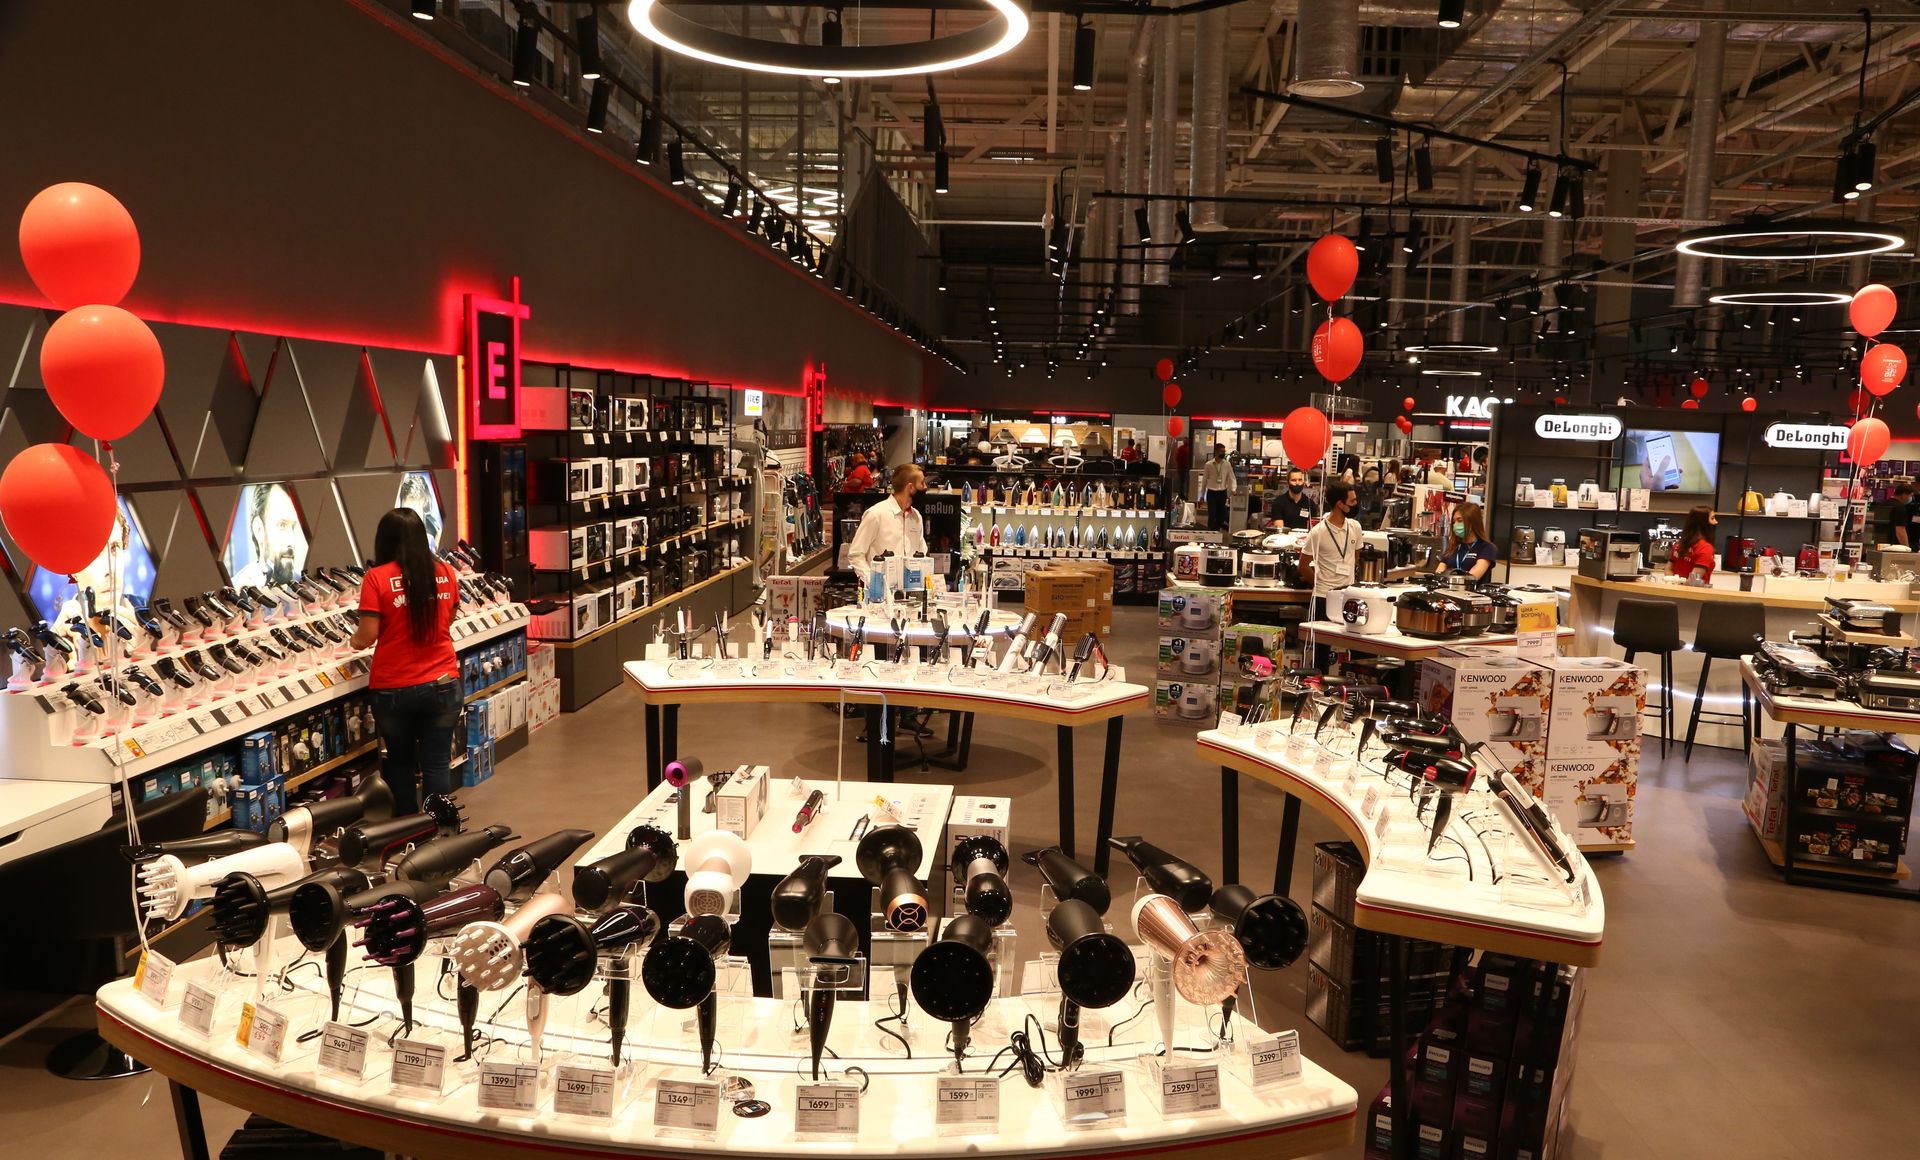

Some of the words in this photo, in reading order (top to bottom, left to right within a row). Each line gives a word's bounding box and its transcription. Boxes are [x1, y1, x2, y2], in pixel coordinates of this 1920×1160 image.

[488, 342, 506, 399] E
[1543, 420, 1613, 437] DeLonghi
[1776, 429, 1845, 446] DeLonghi
[925, 502, 954, 515] BRAUN
[1460, 674, 1507, 683] KENWOOD
[1559, 675, 1604, 683] KENWOOD
[1550, 763, 1595, 772] KENWOOD
[1771, 769, 1780, 794] Tefal
[1766, 806, 1778, 835] Tefal
[333, 1039, 346, 1049] 949
[404, 1055, 420, 1064] 1199
[1259, 1053, 1276, 1063] 2399
[491, 1076, 510, 1085] 1399
[567, 1083, 586, 1092] 1499
[1075, 1088, 1095, 1097] 1999
[1171, 1083, 1191, 1093] 2599
[668, 1094, 689, 1104] 1349
[949, 1092, 969, 1100] 1599
[808, 1100, 829, 1109] 1699
